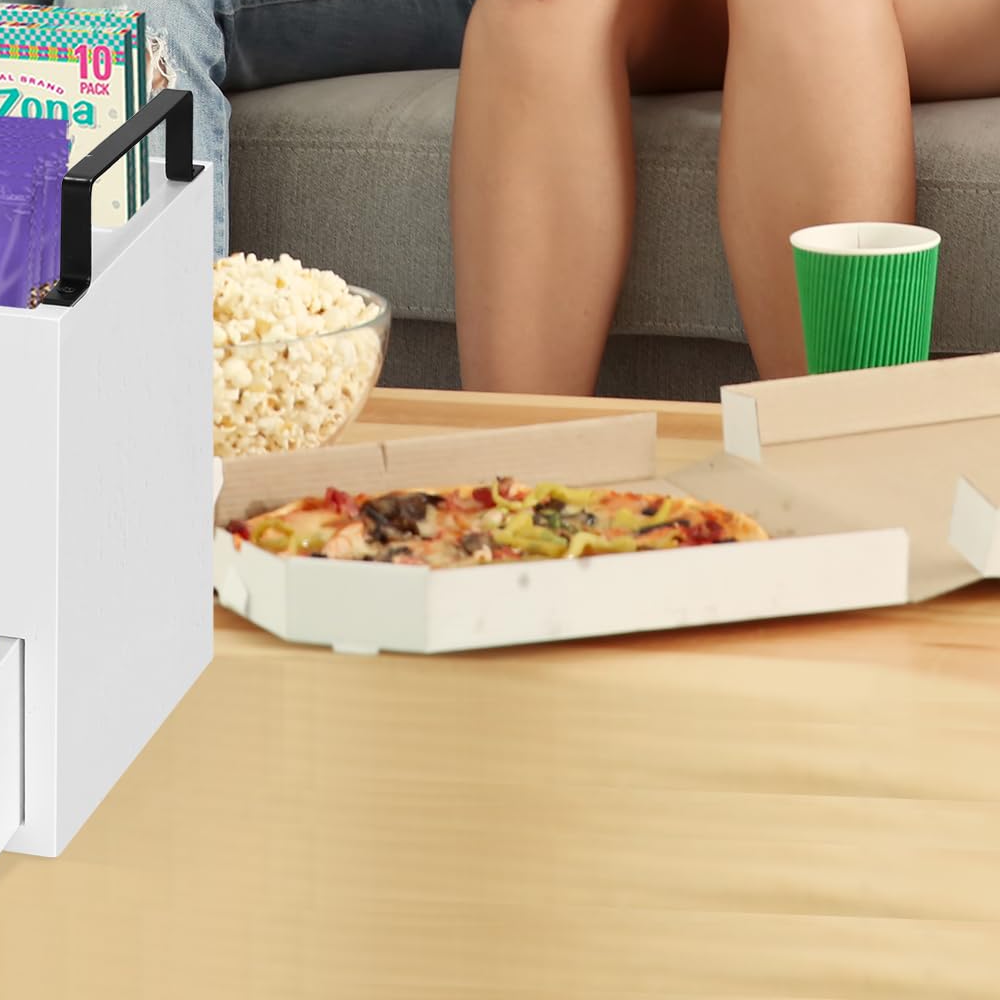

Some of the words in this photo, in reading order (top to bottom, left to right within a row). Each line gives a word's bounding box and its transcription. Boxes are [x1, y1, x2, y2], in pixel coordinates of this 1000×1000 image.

[74, 45, 112, 81] 10
[20, 76, 65, 95] BRAND
[80, 82, 110, 96] PACK
